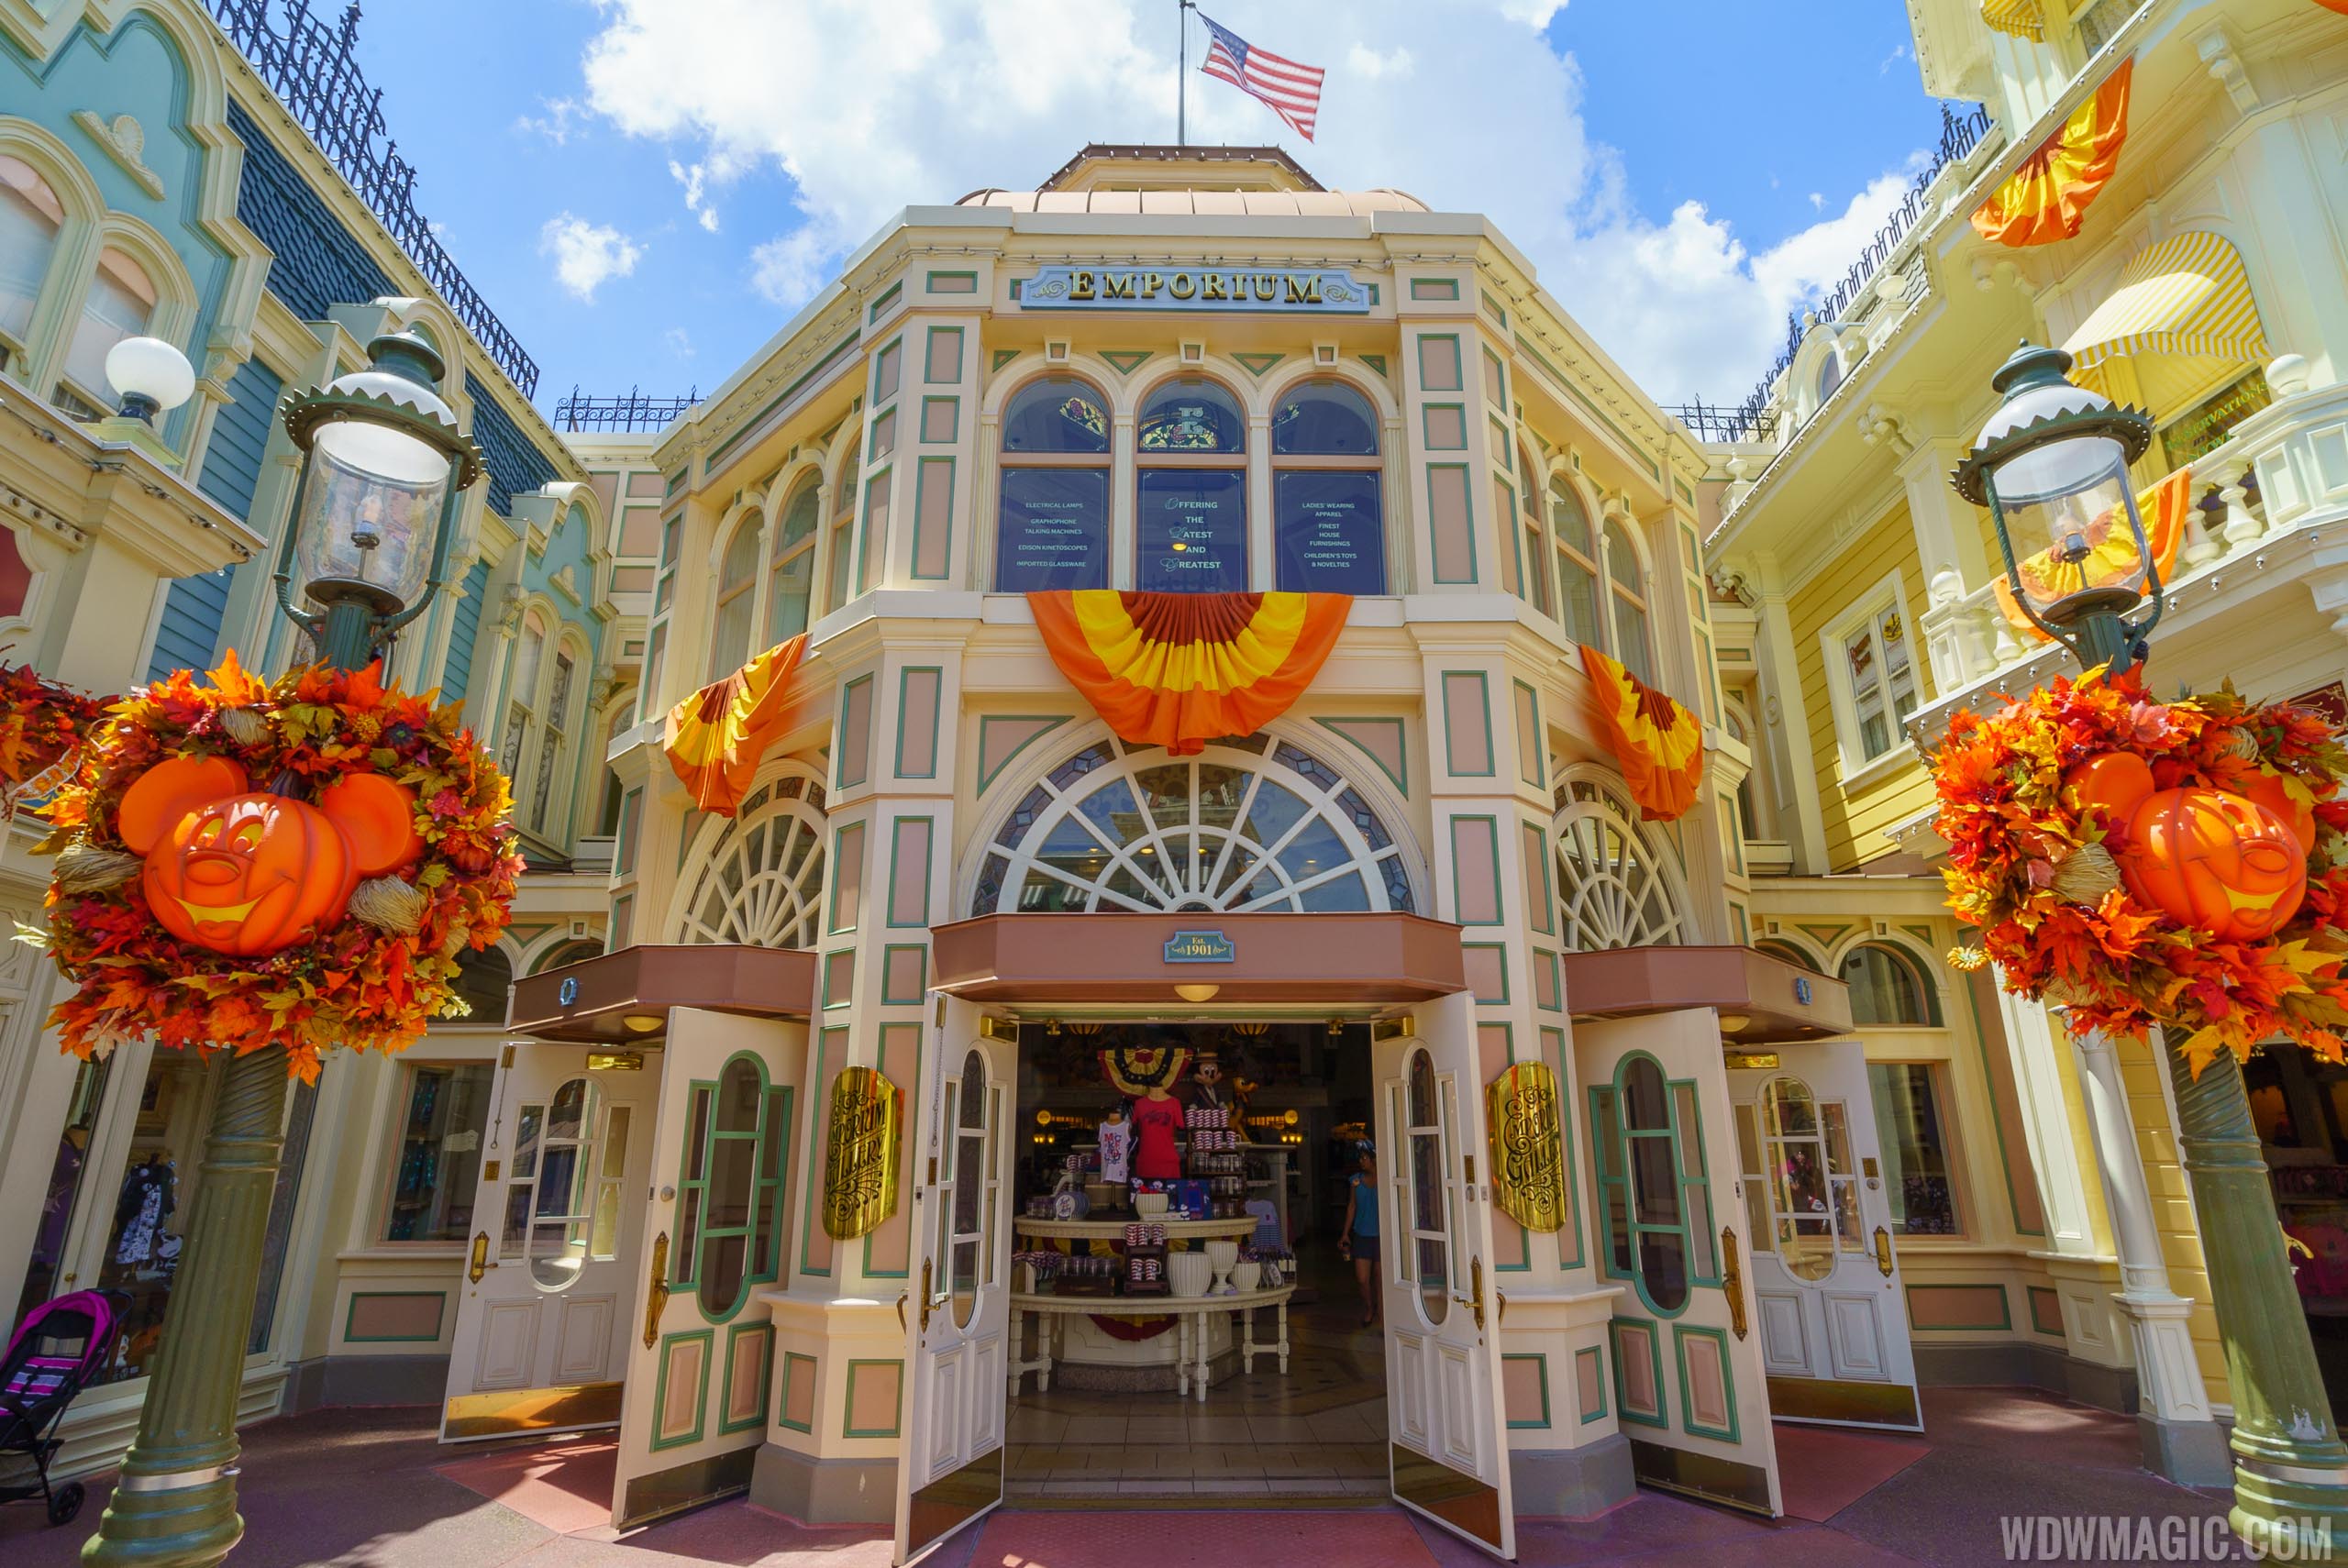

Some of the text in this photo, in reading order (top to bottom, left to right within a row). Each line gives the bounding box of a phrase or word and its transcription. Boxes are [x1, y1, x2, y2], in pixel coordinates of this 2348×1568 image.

[1069, 271, 1323, 303] EMPORIUM
[1165, 497, 1218, 510] OFFERING
[1168, 526, 1213, 540] LATEST
[1159, 558, 1221, 572] GREATEST
[1192, 936, 1205, 944] Est.
[1186, 944, 1212, 955] 1901
